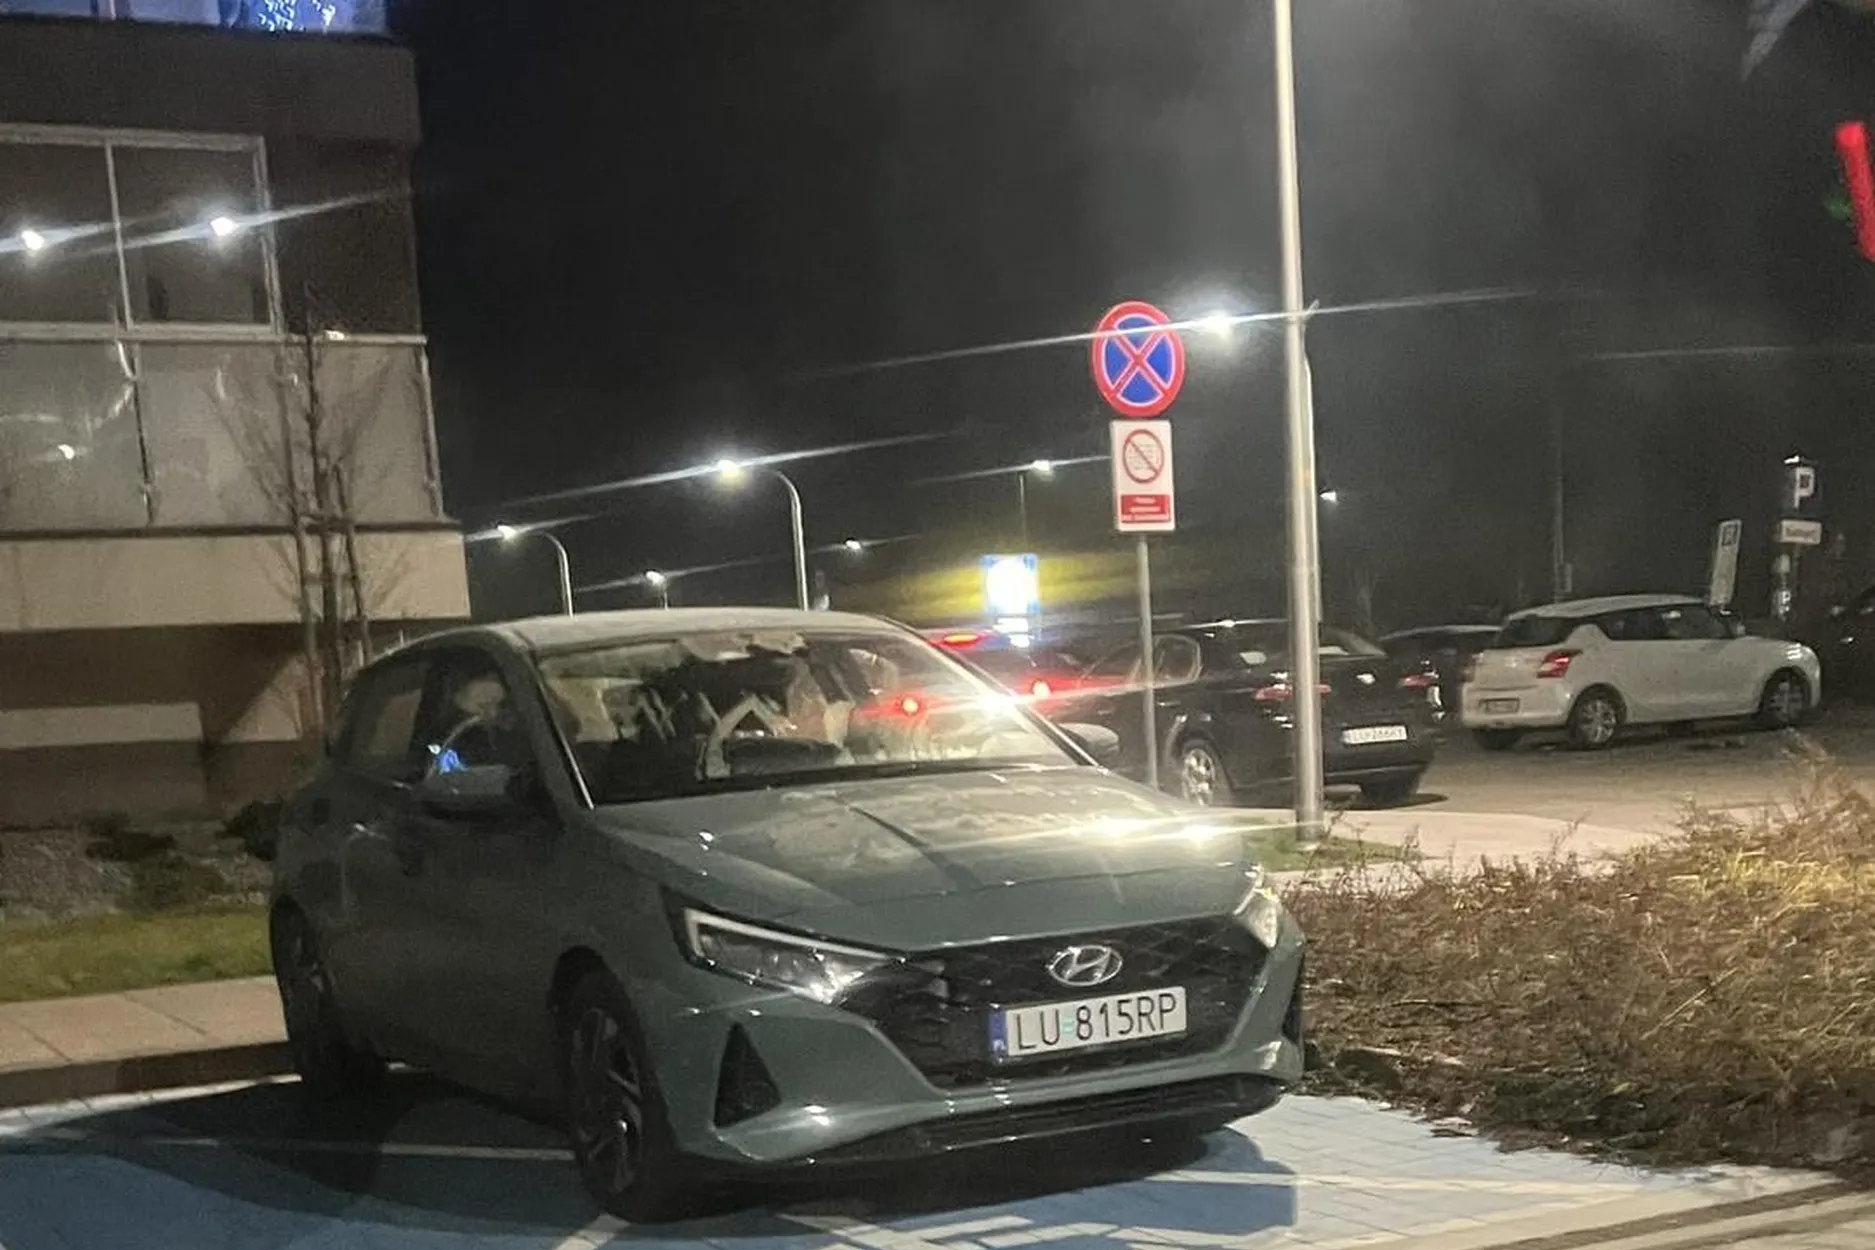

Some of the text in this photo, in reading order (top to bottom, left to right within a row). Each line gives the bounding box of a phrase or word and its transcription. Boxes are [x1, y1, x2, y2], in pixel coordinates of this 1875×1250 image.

[1794, 466, 1815, 508] P
[1016, 993, 1177, 1050] LU 815RP
